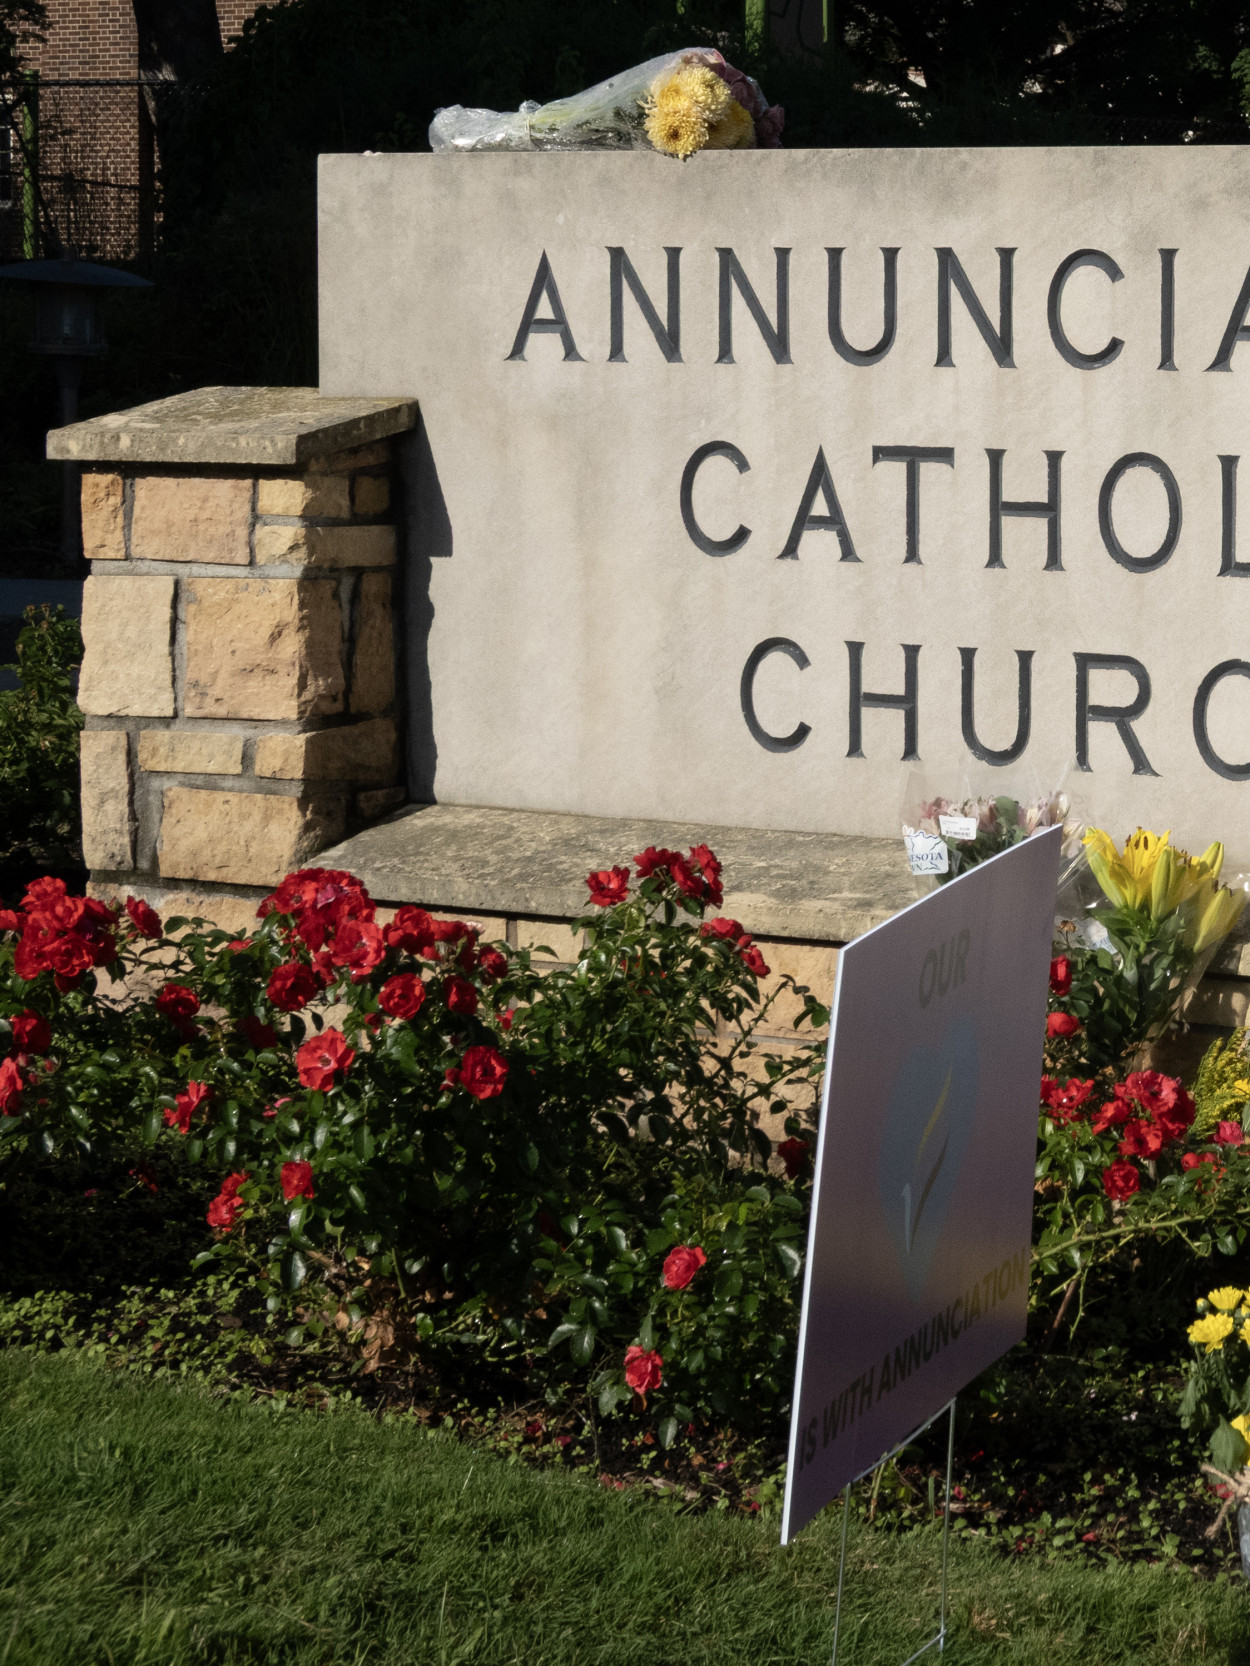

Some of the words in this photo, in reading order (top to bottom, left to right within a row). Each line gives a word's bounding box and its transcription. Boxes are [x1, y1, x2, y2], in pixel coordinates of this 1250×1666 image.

[919, 928, 972, 1009] OUR
[800, 1416, 819, 1472] IS
[822, 1364, 876, 1449] WITH
[877, 1247, 1026, 1404] ANNUNCIATION
